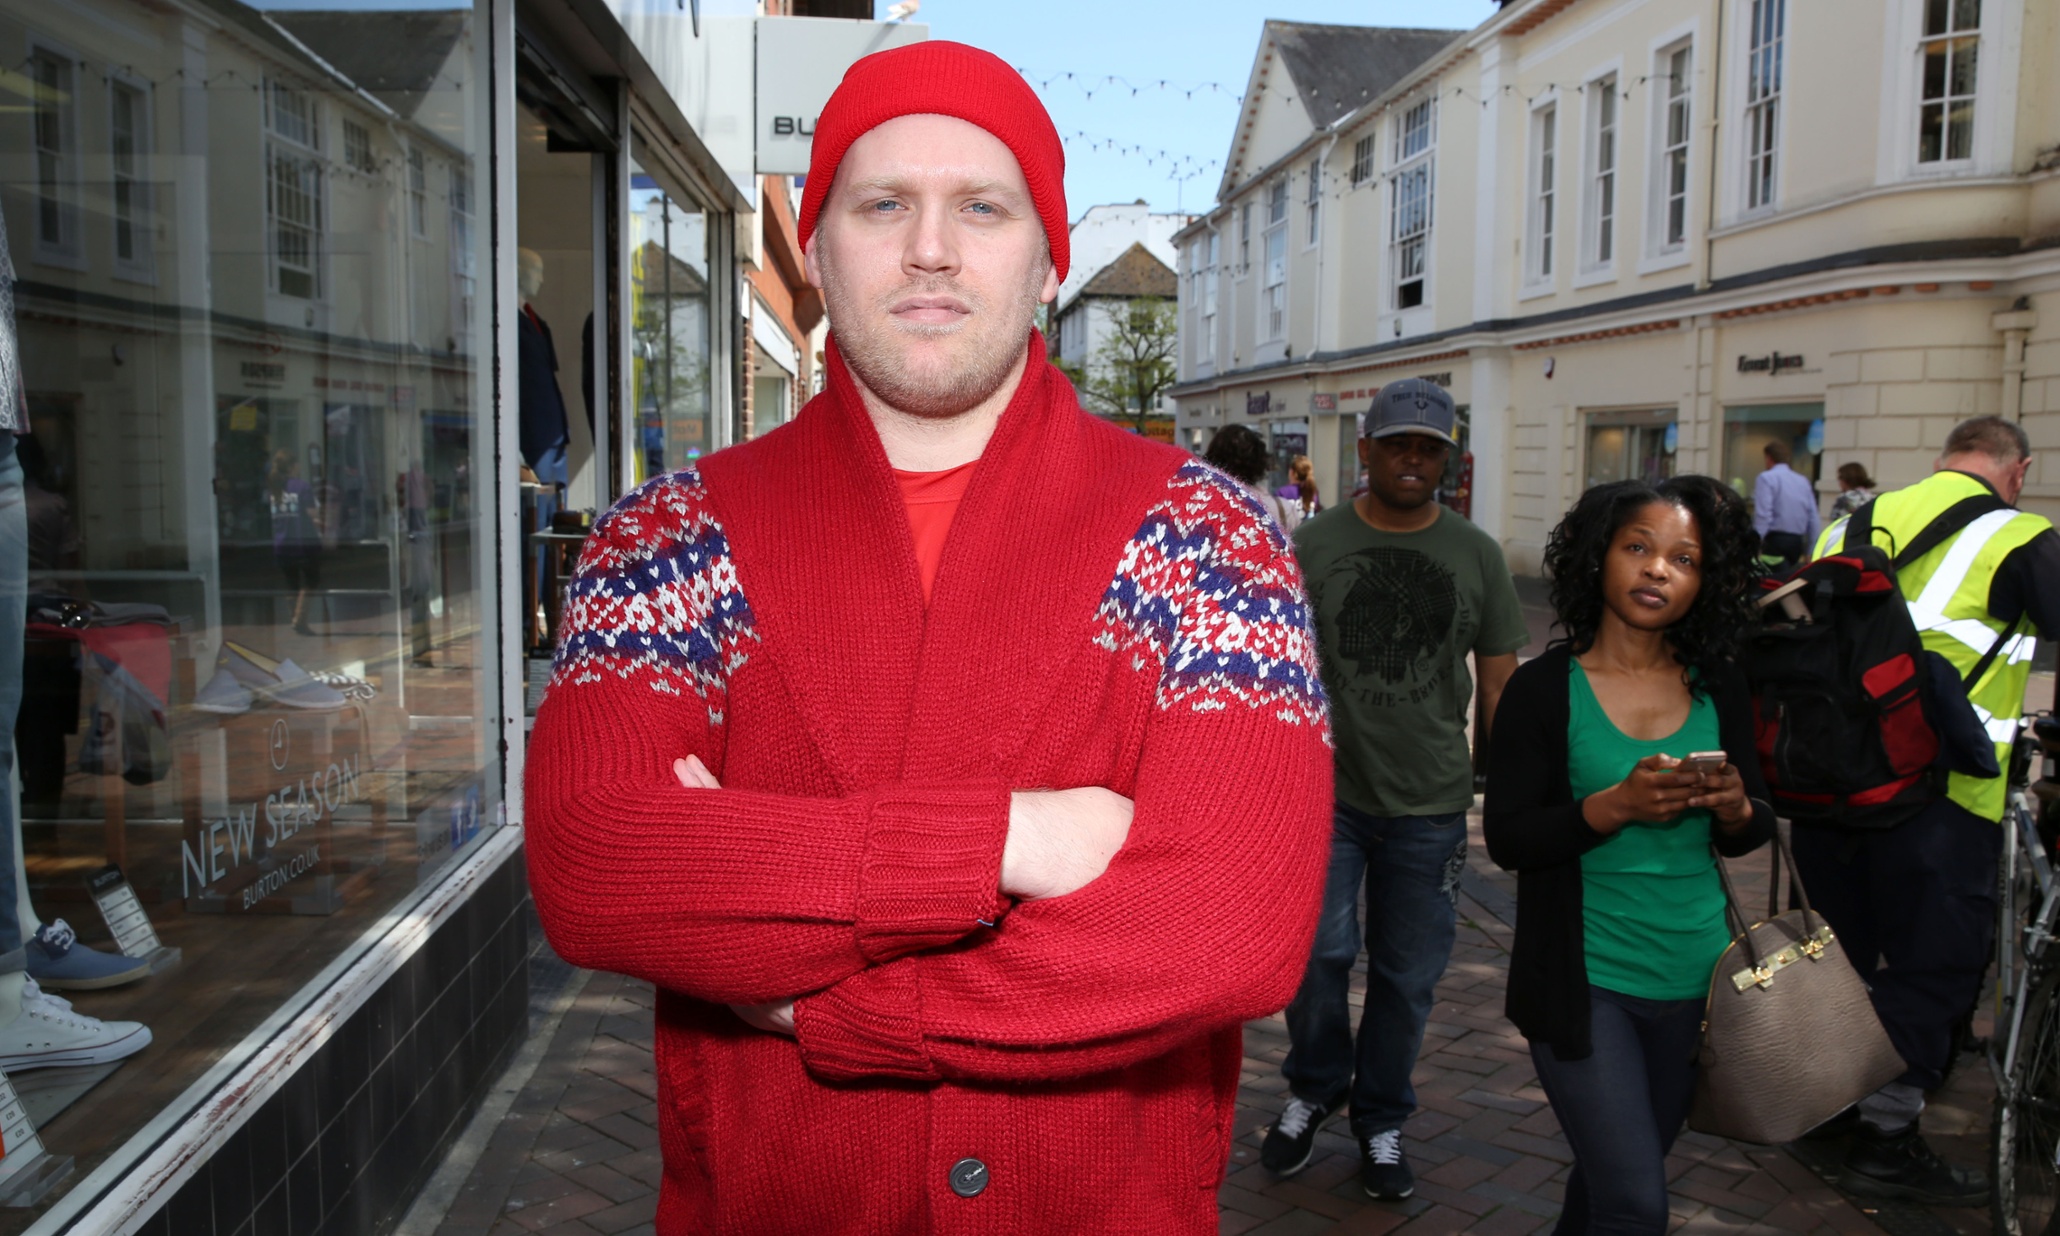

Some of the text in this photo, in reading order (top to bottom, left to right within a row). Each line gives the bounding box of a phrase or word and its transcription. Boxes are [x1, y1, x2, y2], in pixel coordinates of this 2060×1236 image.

[181, 753, 359, 899] NEW SEASON
[243, 844, 321, 910] BURTON.CO.UK
